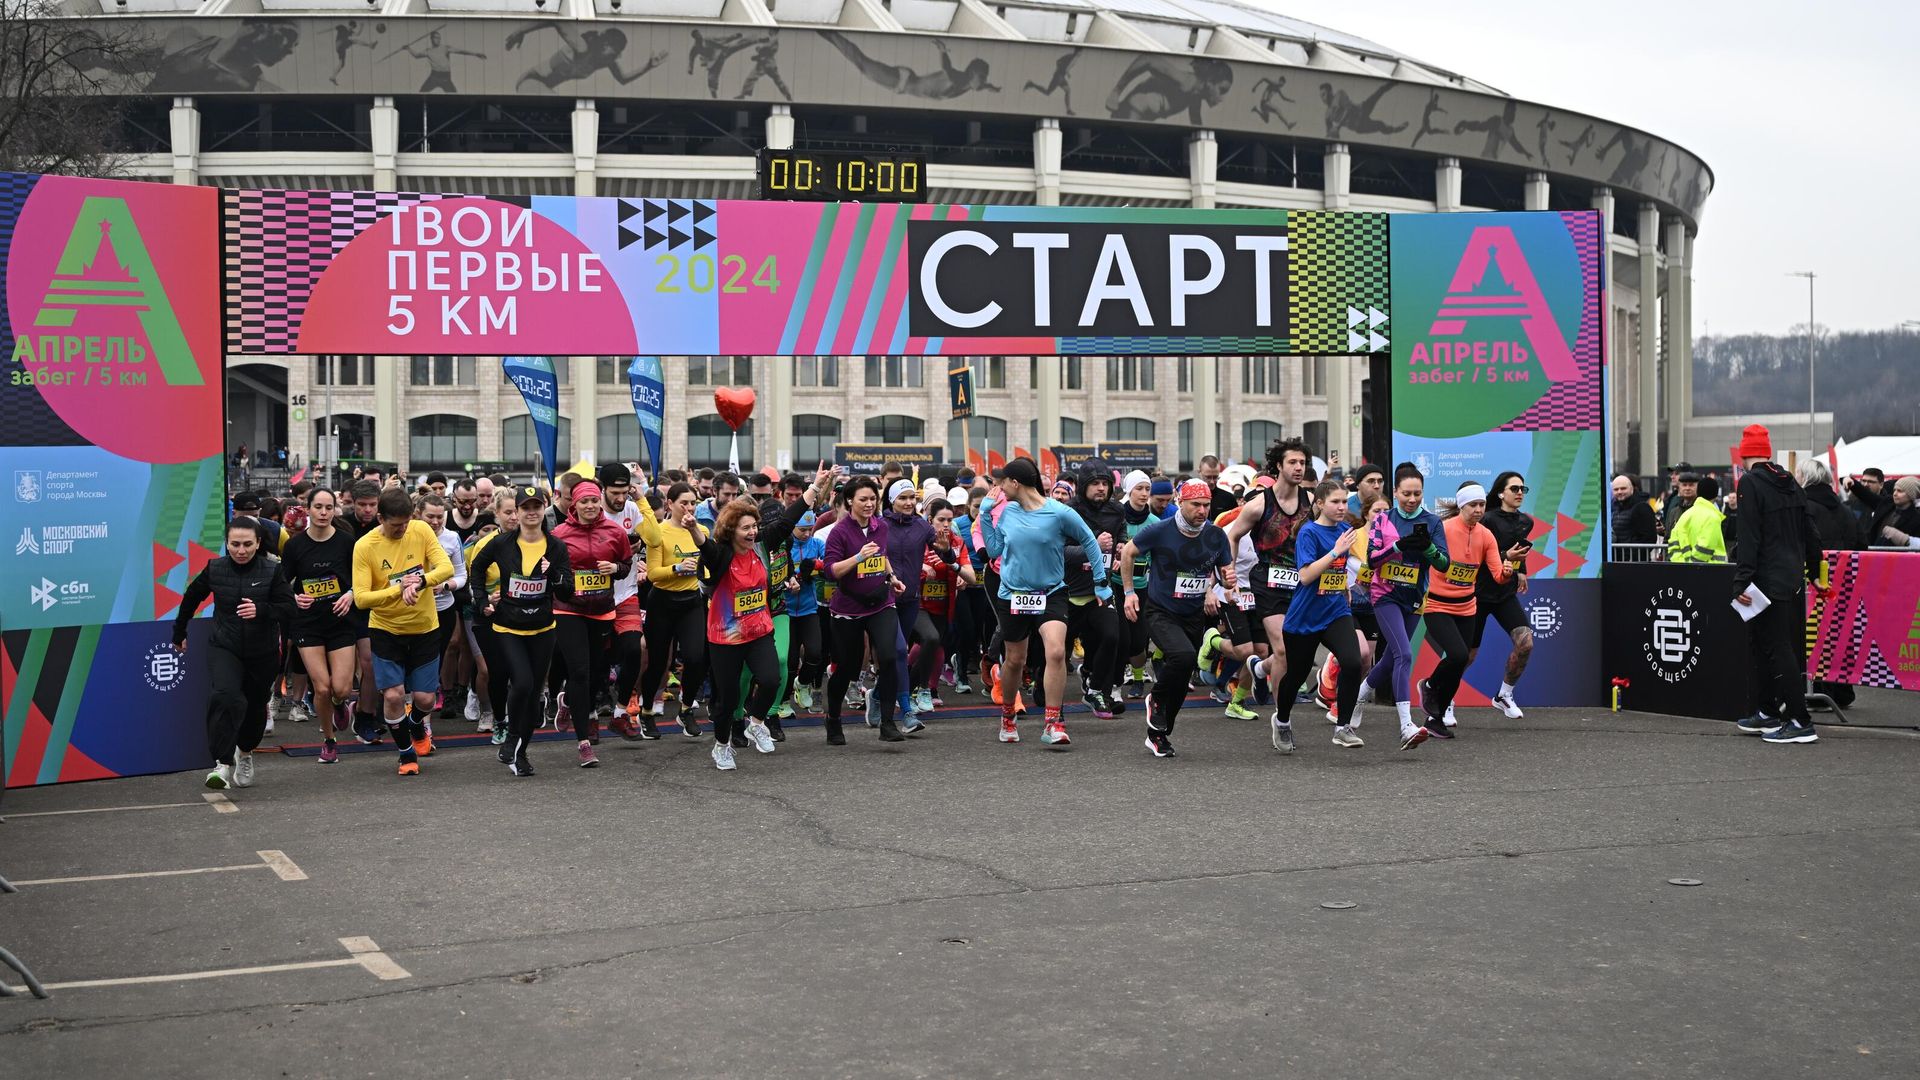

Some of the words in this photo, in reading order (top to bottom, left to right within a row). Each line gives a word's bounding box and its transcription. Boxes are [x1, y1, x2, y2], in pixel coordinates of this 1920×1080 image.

[771, 159, 917, 193] 00:10:00
[383, 206, 533, 247] ТВОИ
[388, 250, 600, 292] ПЕРВЫЕ
[655, 254, 781, 294] 2024
[920, 230, 1288, 329] СТАРТ
[387, 296, 415, 335] 5
[441, 296, 517, 336] КМ
[11, 335, 147, 363] АПРЕЛЬ
[1409, 342, 1529, 365] АПРЕЛЬ
[10, 367, 76, 386] забег
[100, 369, 112, 385] 5
[120, 374, 147, 385] км
[1409, 368, 1465, 384] забег
[1487, 369, 1497, 382] 5
[1504, 371, 1529, 382] км
[292, 395, 307, 406] 16
[1353, 405, 1361, 414] 17
[845, 452, 882, 461] Женская
[885, 453, 933, 462] раздевалка
[1439, 452, 1484, 460] Департамент
[46, 471, 99, 480] Департамент
[47, 482, 74, 490] спорта
[47, 492, 75, 500] города
[76, 490, 107, 498] Москвы
[43, 522, 108, 540] МОСКОВСКИЙ
[43, 540, 73, 555] СПОРТ
[863, 558, 882, 569] 1401
[1273, 570, 1299, 582] 2270
[1387, 565, 1414, 579] 1044
[1451, 567, 1475, 578] 5577
[308, 580, 335, 594] 3275
[514, 581, 542, 592] 7000
[580, 575, 606, 586] 1820
[1180, 579, 1205, 589] 4471
[1323, 574, 1344, 586] 4589
[60, 581, 89, 594] сбп
[927, 585, 946, 593] 391
[739, 593, 763, 607] 5840
[1015, 596, 1042, 606] 3066
[1644, 587, 1699, 619] БЕГОВОЕ
[1531, 621, 1563, 639] ОБЩЕСТВО
[1643, 642, 1701, 683] СООБЩЕСТВО
